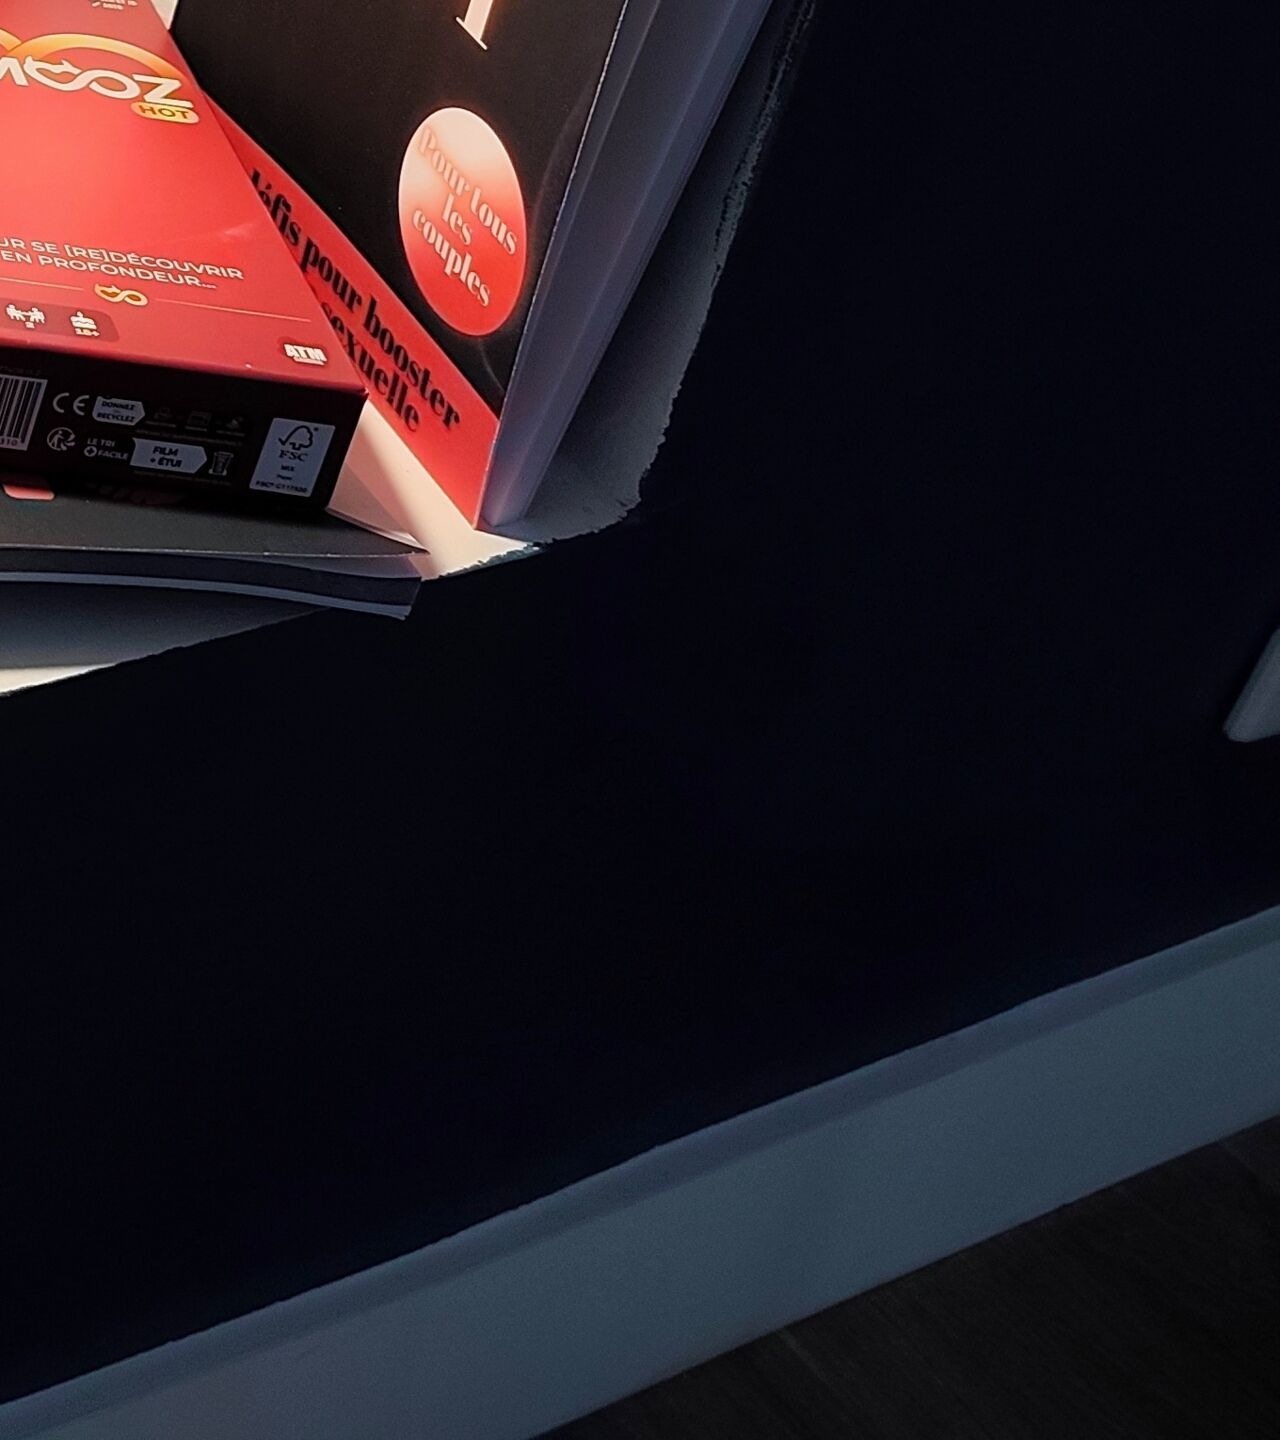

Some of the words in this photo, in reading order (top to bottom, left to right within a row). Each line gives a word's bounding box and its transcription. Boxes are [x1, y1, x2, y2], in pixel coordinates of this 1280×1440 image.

[138, 103, 190, 123] HOT
[418, 125, 470, 198] Pour
[470, 187, 518, 255] tous
[443, 192, 473, 246] les
[1, 250, 32, 264] EN
[31, 241, 58, 255] SE
[412, 209, 490, 307] couples
[251, 168, 301, 247] éfis
[299, 235, 362, 315] pour
[363, 292, 461, 432] booster
[151, 445, 180, 457] FILM
[278, 449, 308, 462] FSC
